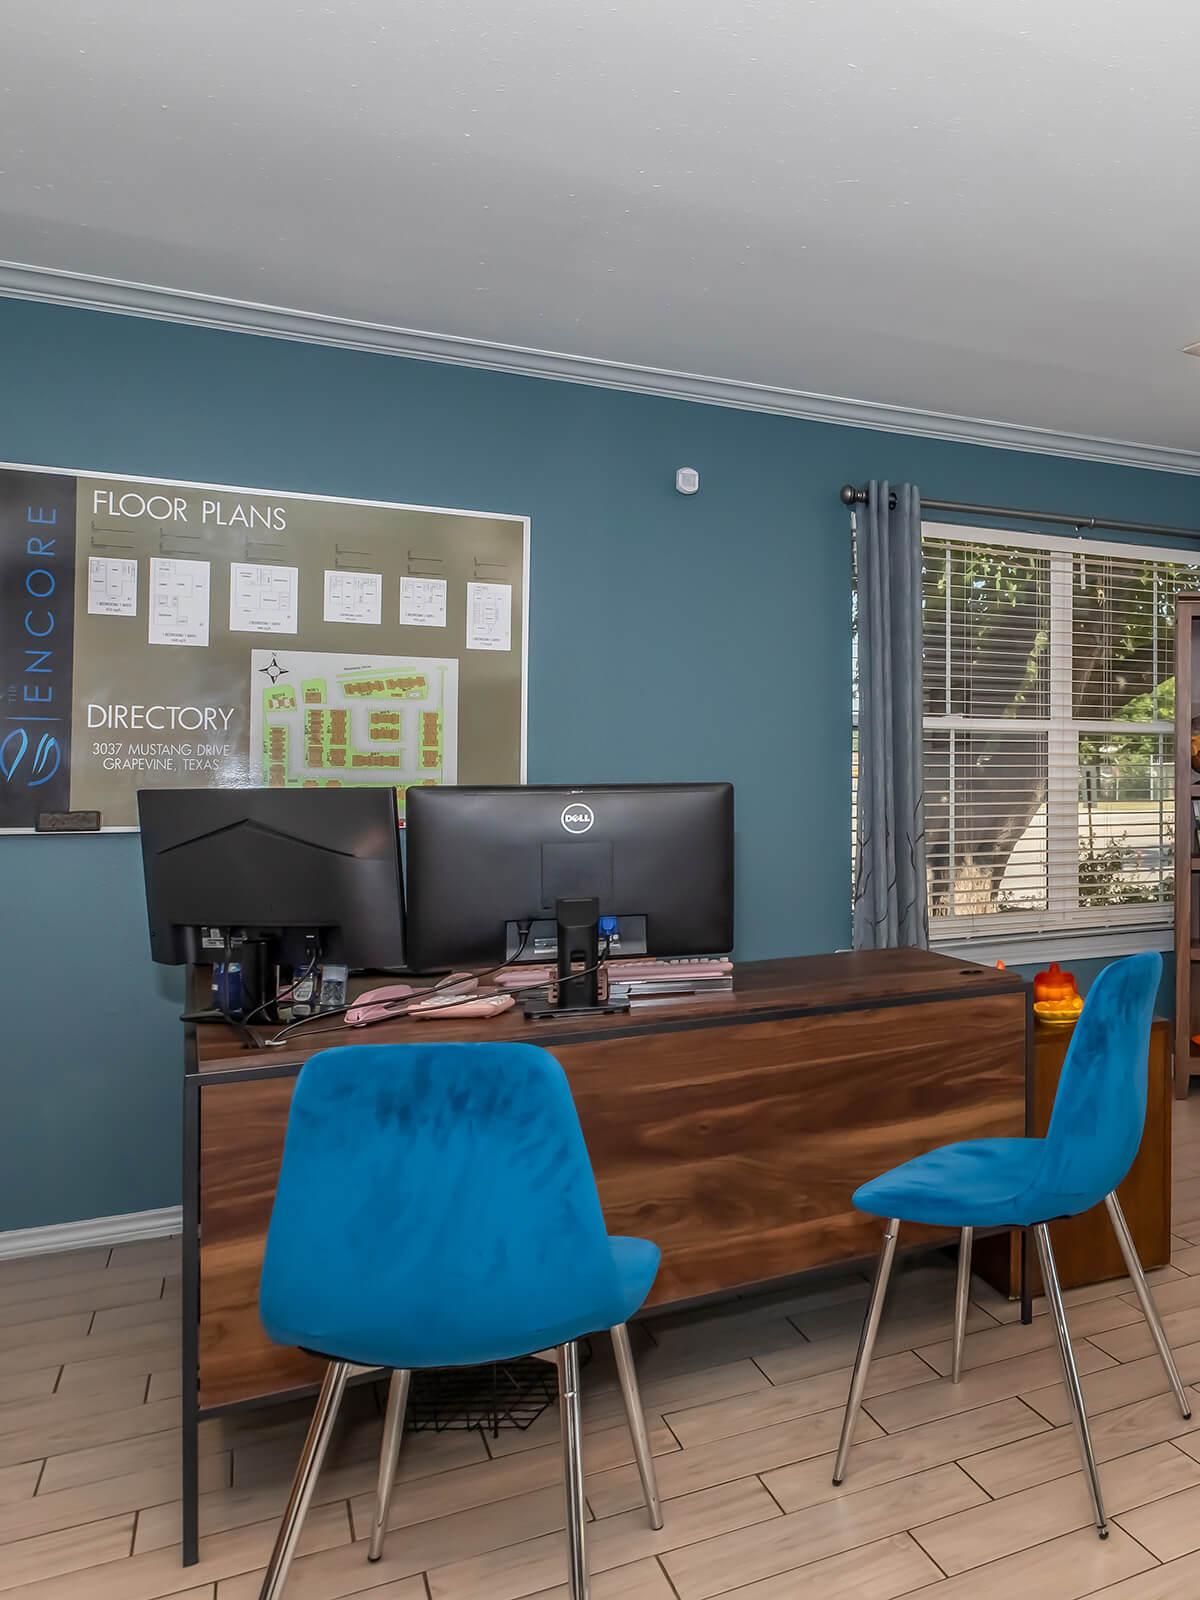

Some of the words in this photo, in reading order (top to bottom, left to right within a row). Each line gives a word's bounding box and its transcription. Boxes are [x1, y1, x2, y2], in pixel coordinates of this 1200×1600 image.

[93, 490, 187, 522] FLOOR
[202, 500, 286, 531] PLANS
[23, 506, 57, 703] ENCORE
[87, 704, 234, 730] DIRECTORY
[92, 743, 123, 756] 3037
[128, 744, 192, 756] MUSTANG
[197, 744, 230, 757] DRIVE
[103, 758, 177, 772] GRAPEVINE,
[183, 759, 220, 771] TEXAS
[565, 814, 591, 822] DELL
